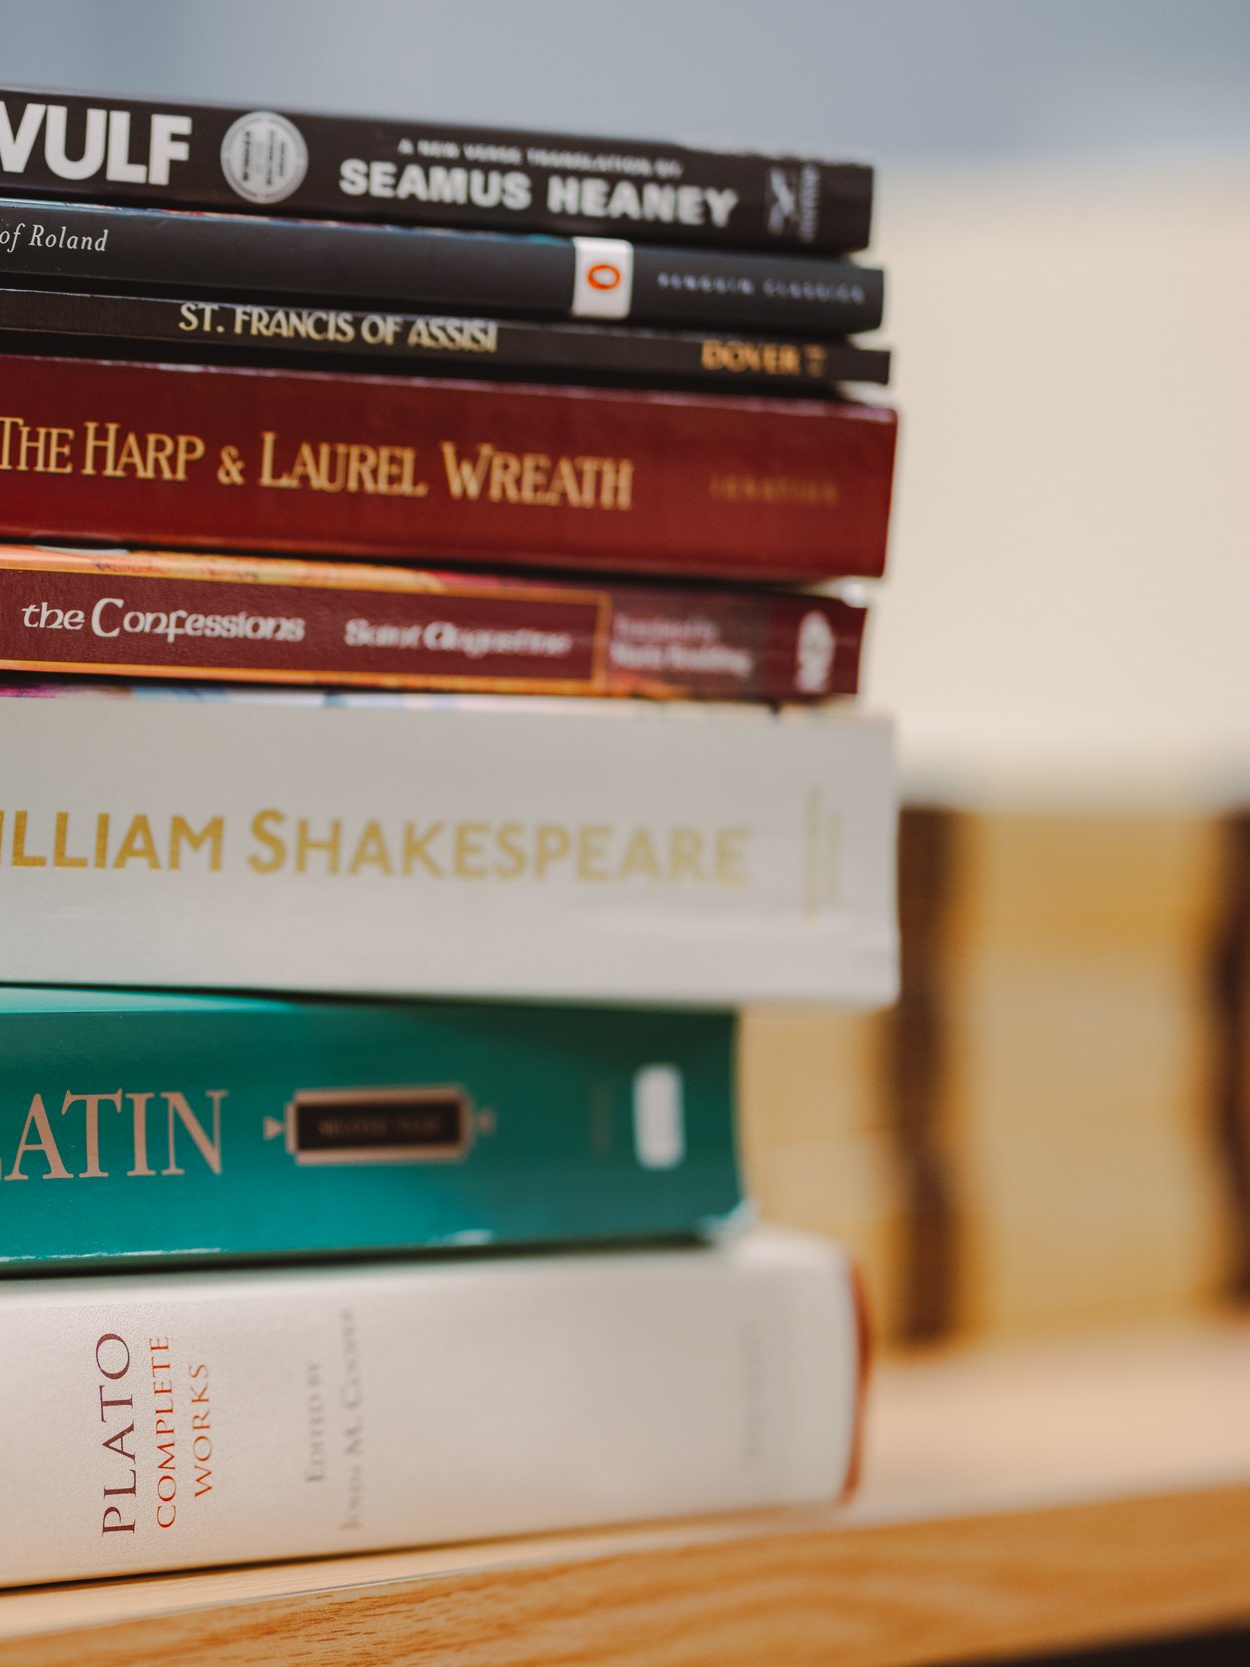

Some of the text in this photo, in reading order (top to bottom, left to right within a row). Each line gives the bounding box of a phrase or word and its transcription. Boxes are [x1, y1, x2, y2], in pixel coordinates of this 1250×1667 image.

[339, 159, 532, 211] SEAMUS
[547, 175, 739, 229] HEANEY
[0, 221, 26, 253] of
[29, 223, 109, 254] Roland
[178, 302, 499, 352] ST. FRANCIS OF ASSISI
[701, 339, 801, 376] DOVER
[81, 421, 205, 482] HARP
[216, 444, 246, 486] &
[260, 430, 428, 497] LAUREL
[439, 440, 634, 512] WREATH
[21, 597, 306, 643] the Confessions
[247, 808, 751, 888] SHAKESPEARE
[95, 1332, 136, 1538] PLATO
[149, 1336, 177, 1529] COMPLETE
[188, 1363, 213, 1498] WORKS
